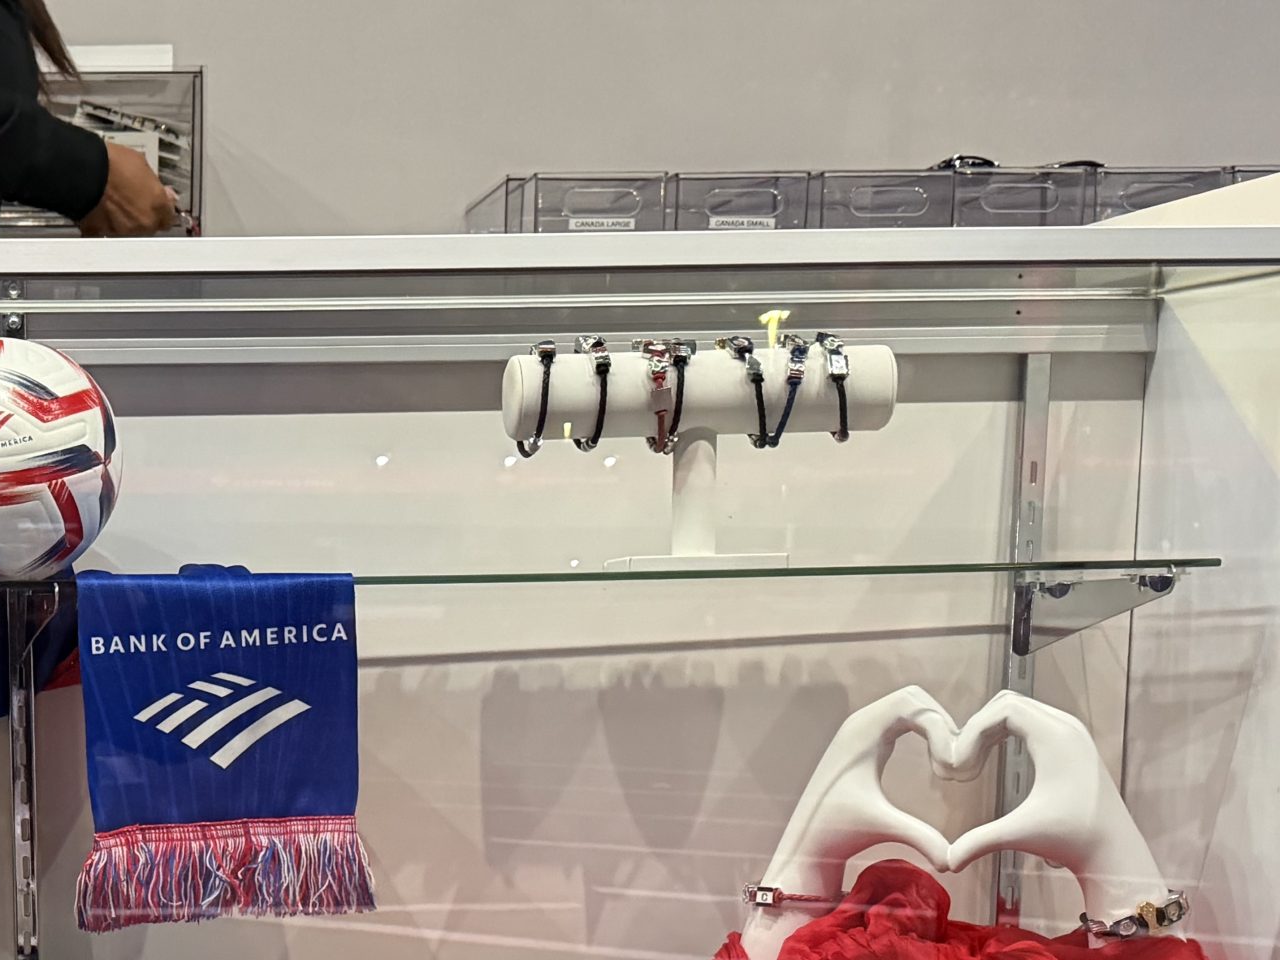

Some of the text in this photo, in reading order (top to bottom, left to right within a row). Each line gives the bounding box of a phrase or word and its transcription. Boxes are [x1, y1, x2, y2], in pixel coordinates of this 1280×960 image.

[574, 220, 631, 228] CANADA LARGE
[715, 219, 770, 228] CANADA SMALL
[90, 622, 348, 655] BANK OF AMERICA
